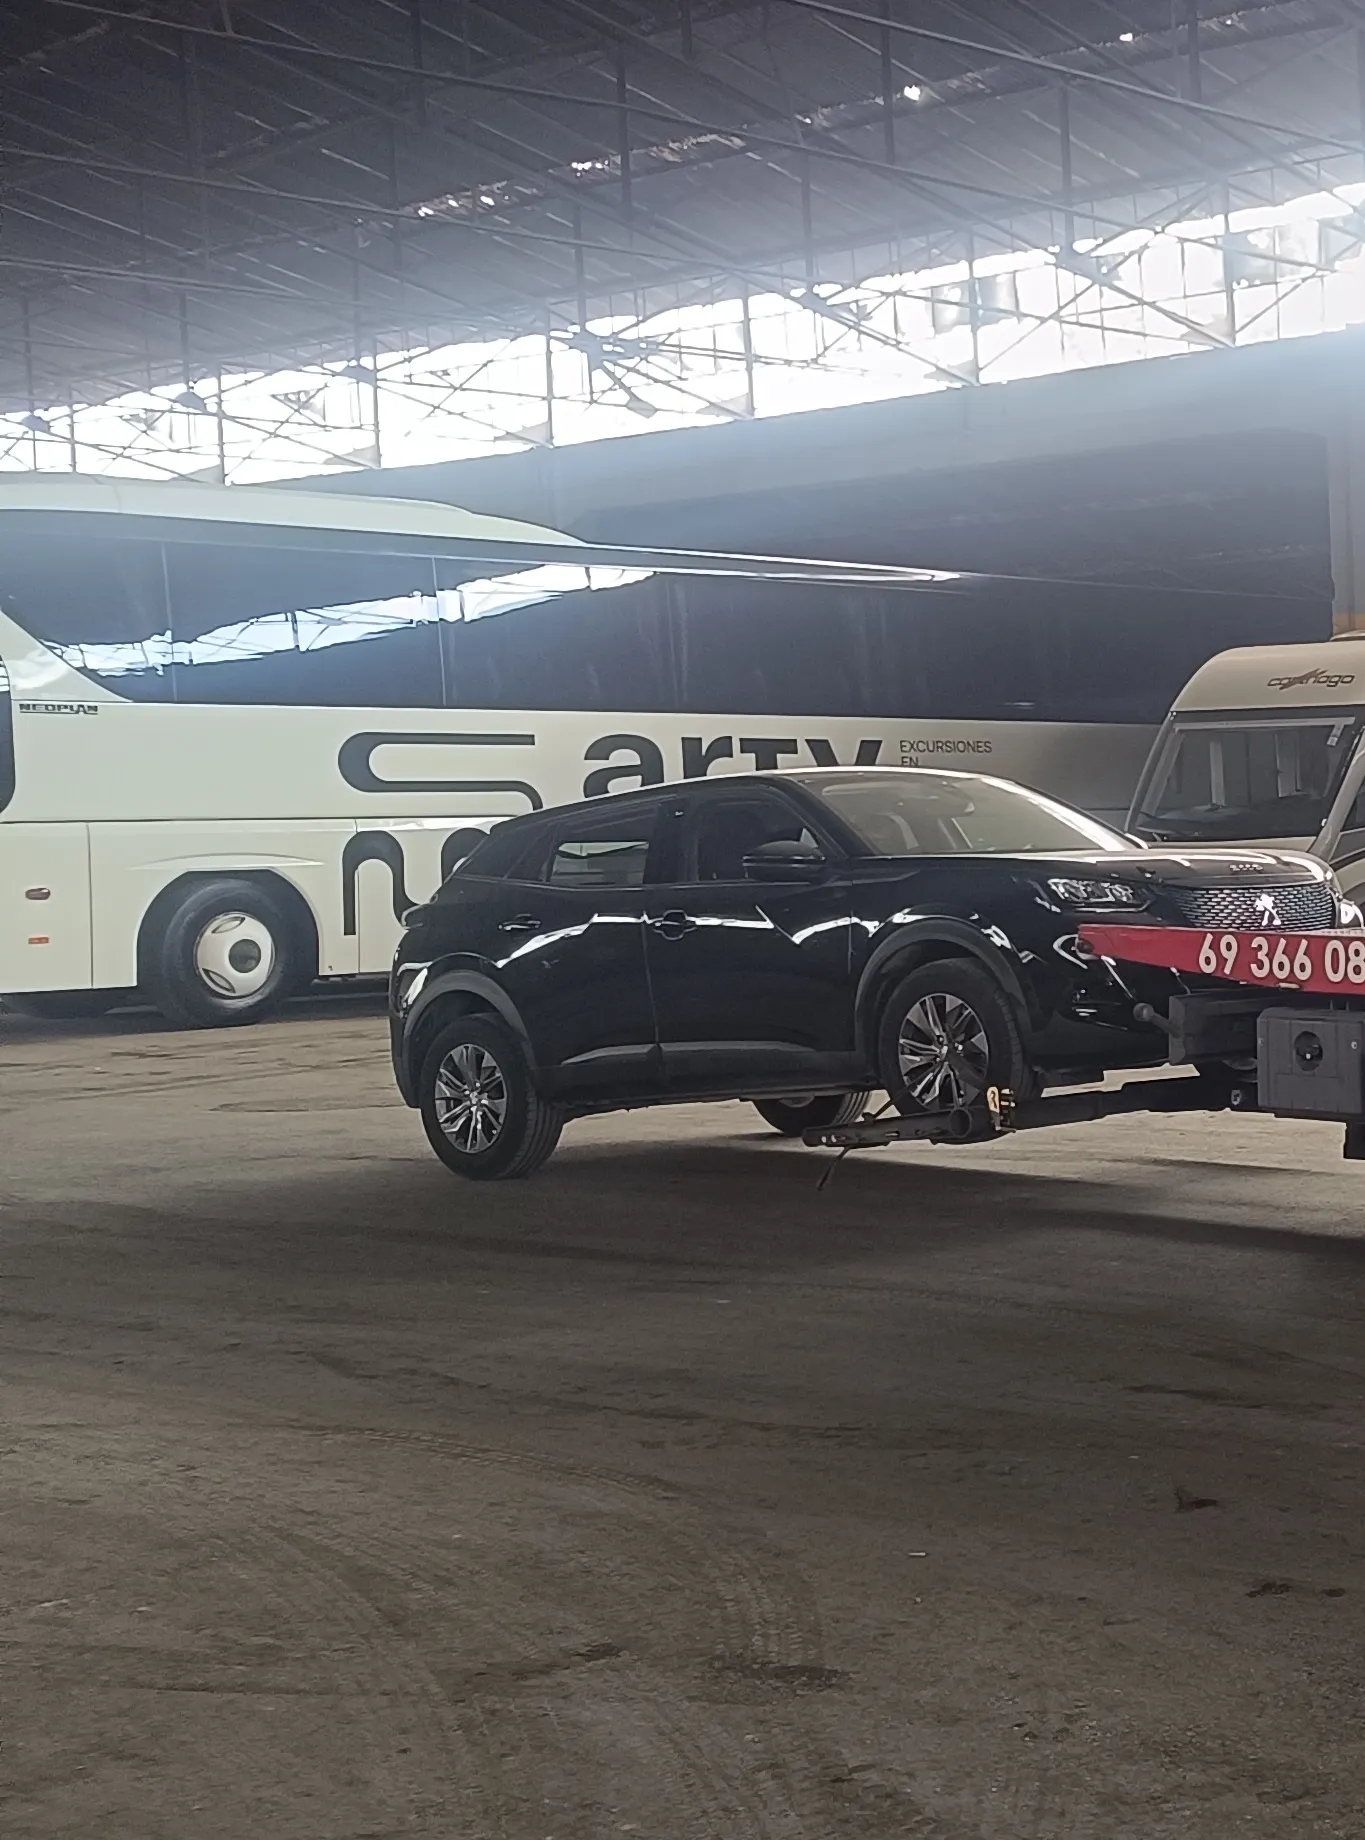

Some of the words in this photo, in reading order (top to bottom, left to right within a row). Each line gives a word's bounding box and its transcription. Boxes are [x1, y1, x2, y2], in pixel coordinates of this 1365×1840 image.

[19, 703, 98, 715] NEOPLAN
[900, 740, 992, 753] EXCURSIONES
[901, 756, 919, 766] EN
[1198, 932, 1238, 975] 69
[1250, 936, 1312, 981] 366
